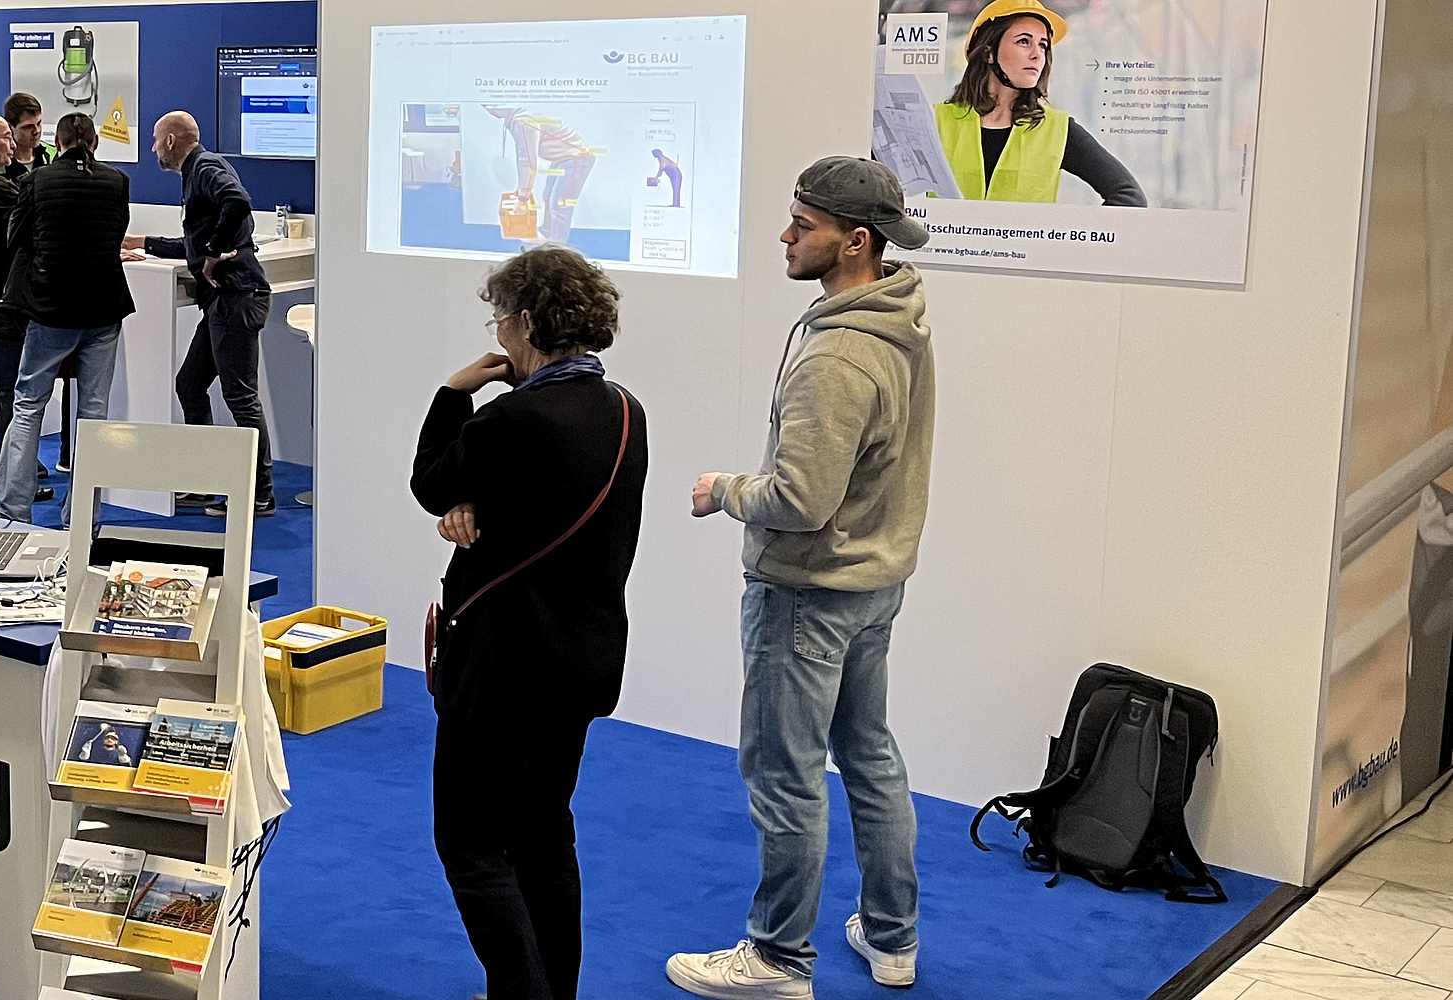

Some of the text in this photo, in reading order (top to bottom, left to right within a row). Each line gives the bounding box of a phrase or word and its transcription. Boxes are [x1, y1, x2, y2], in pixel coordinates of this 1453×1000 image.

[893, 26, 939, 43] AMS
[627, 52, 679, 64] BG BAU
[905, 54, 938, 65] BAU
[1105, 61, 1155, 69] Ihre Vorteile:
[474, 77, 609, 86] Das Kreuz mit dem Kreuz
[1111, 101, 1151, 109] Beschäftigte
[1153, 102, 1186, 110] langfristig
[1109, 127, 1169, 135] Rechtskonformität
[905, 207, 927, 218] BAU
[1047, 229, 1067, 240] der
[1070, 230, 1087, 242] BG
[1090, 231, 1115, 243] BAU
[934, 247, 1026, 259] www.bgbau.de/ams-bau
[1332, 737, 1399, 808] www.bgbau.de
